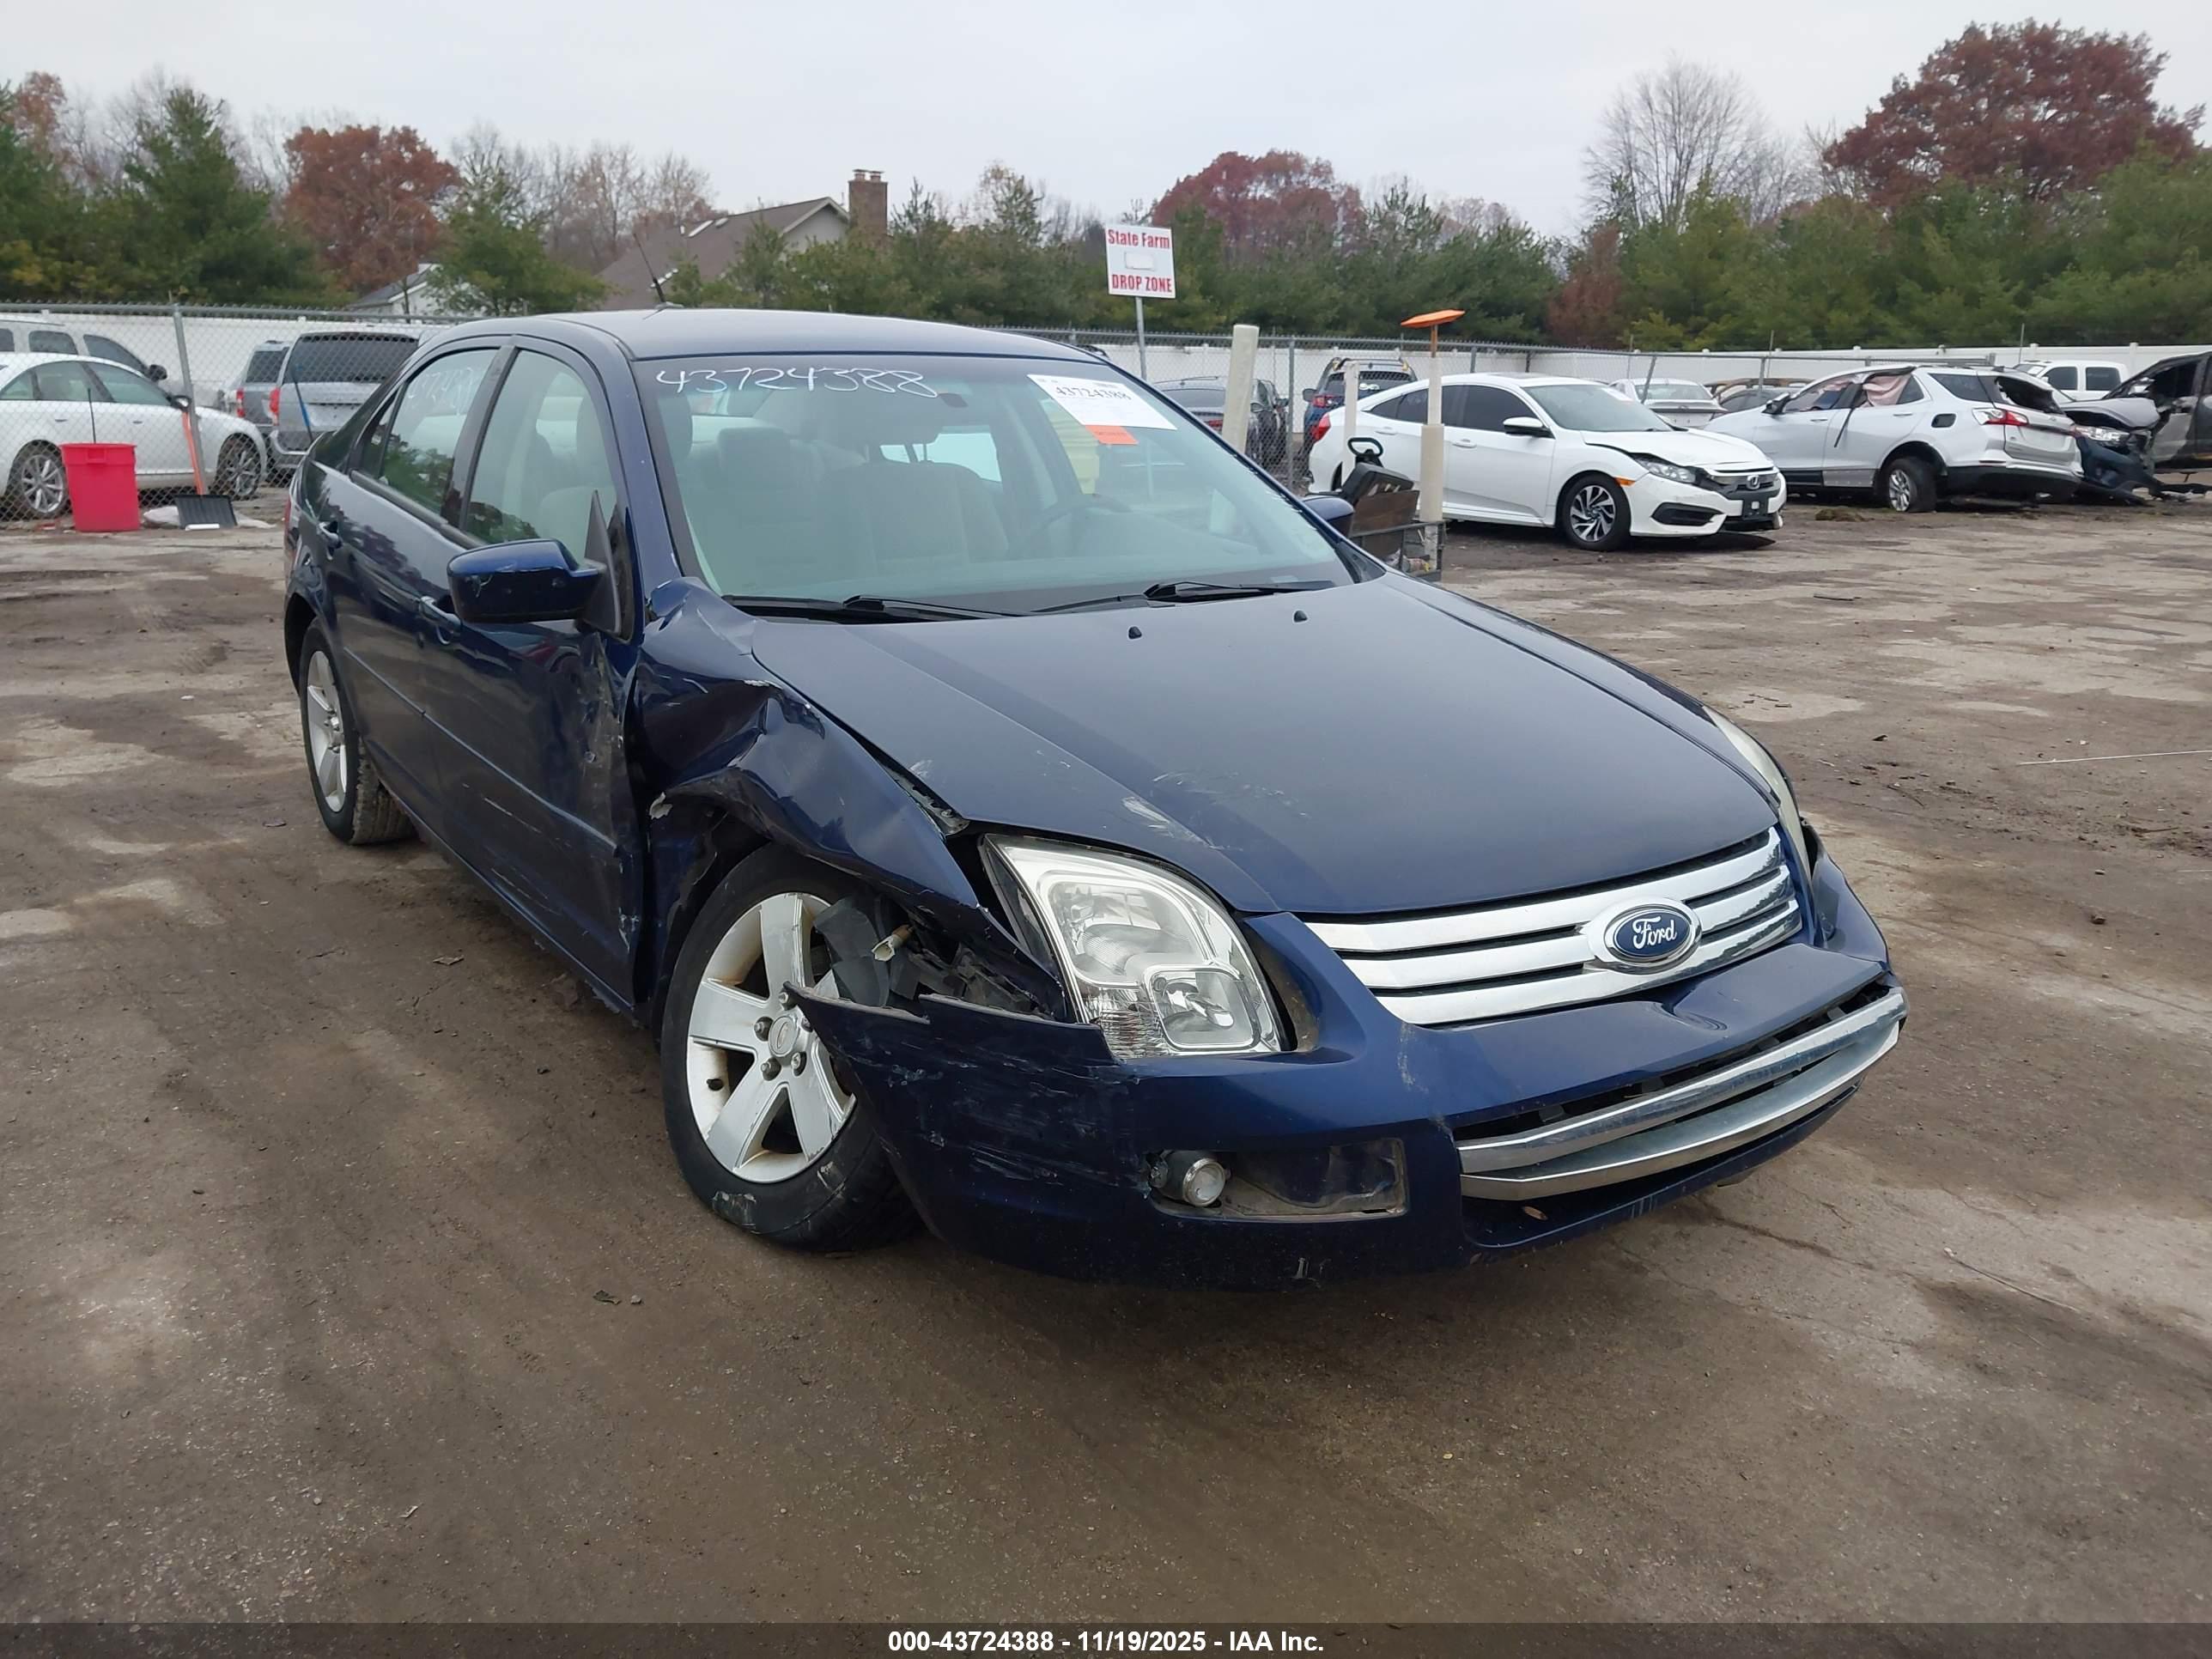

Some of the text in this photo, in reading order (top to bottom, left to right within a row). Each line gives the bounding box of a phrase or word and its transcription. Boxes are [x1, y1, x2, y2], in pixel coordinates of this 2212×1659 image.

[1108, 229, 1170, 249] State Farm
[1112, 274, 1172, 293] DROP ZONE
[656, 367, 939, 398] 43724388
[1632, 915, 1678, 950] Ford
